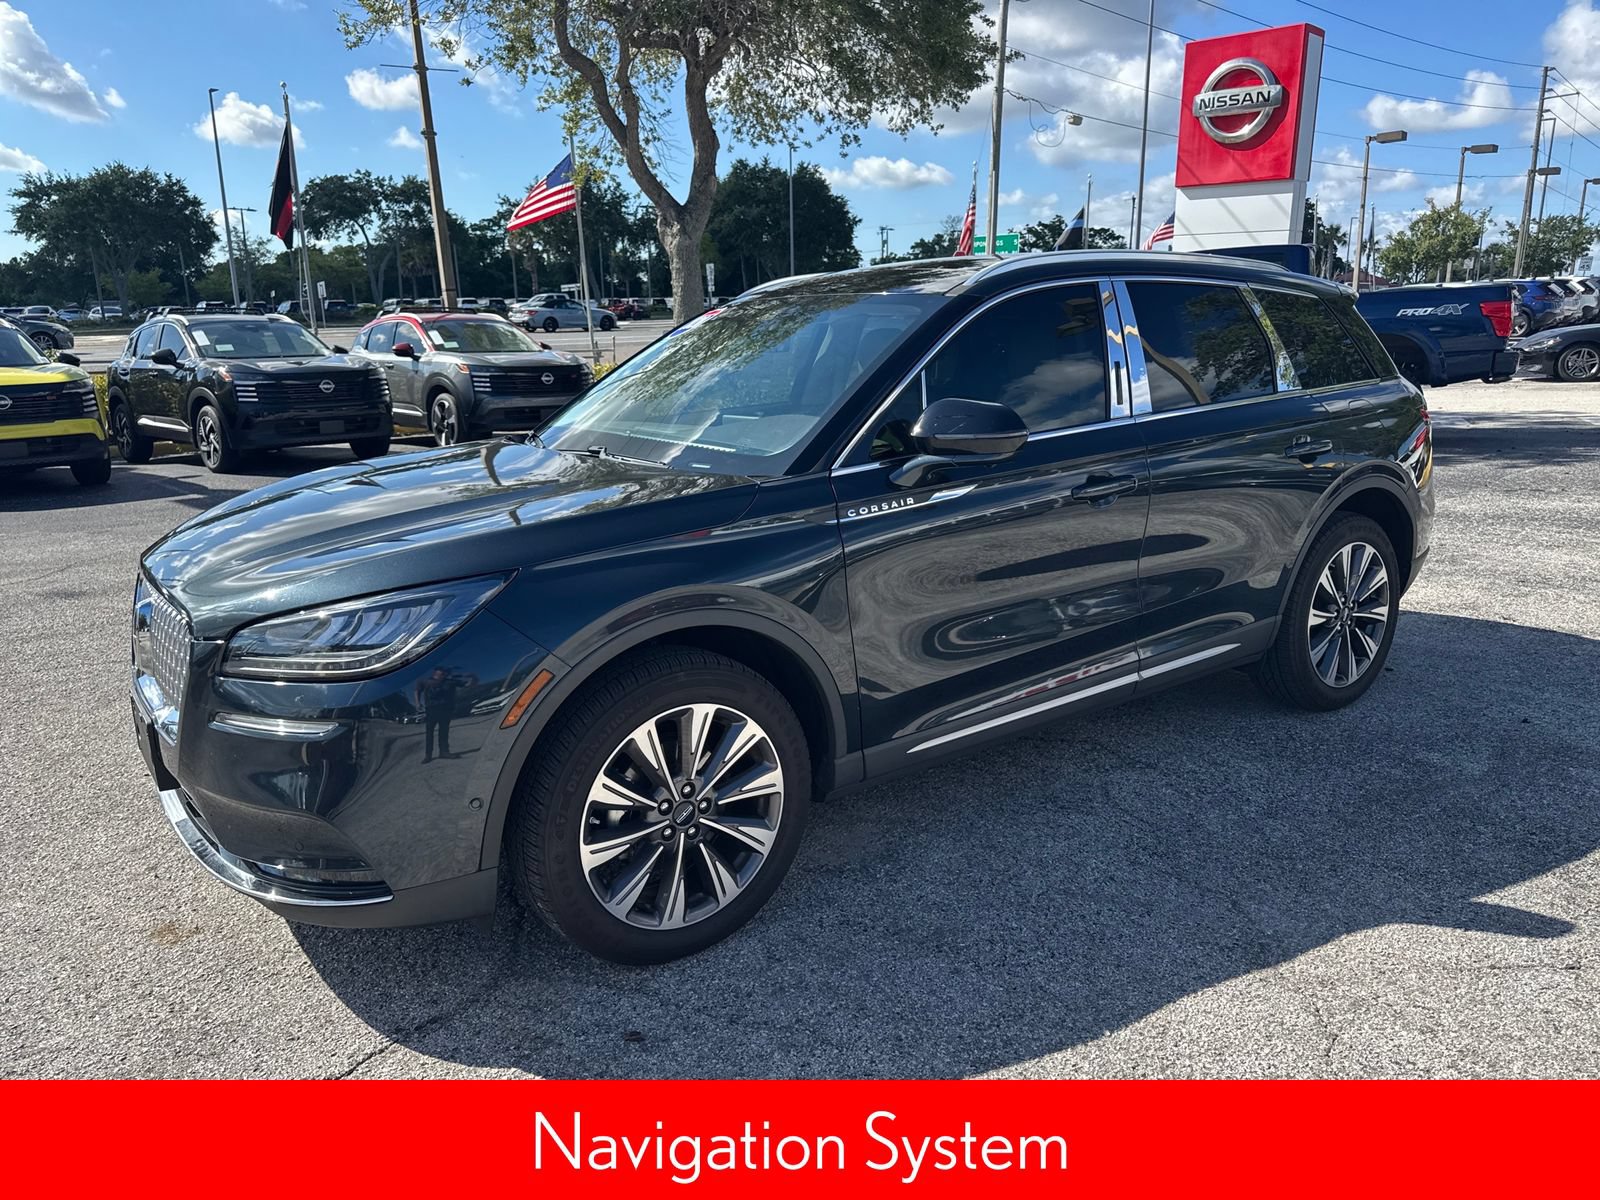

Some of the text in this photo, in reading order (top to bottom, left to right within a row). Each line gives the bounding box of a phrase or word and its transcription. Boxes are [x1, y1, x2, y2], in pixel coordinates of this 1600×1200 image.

[1199, 90, 1272, 111] NISSAN
[847, 497, 915, 517] CORSAIR
[566, 706, 635, 793] DESTINATION
